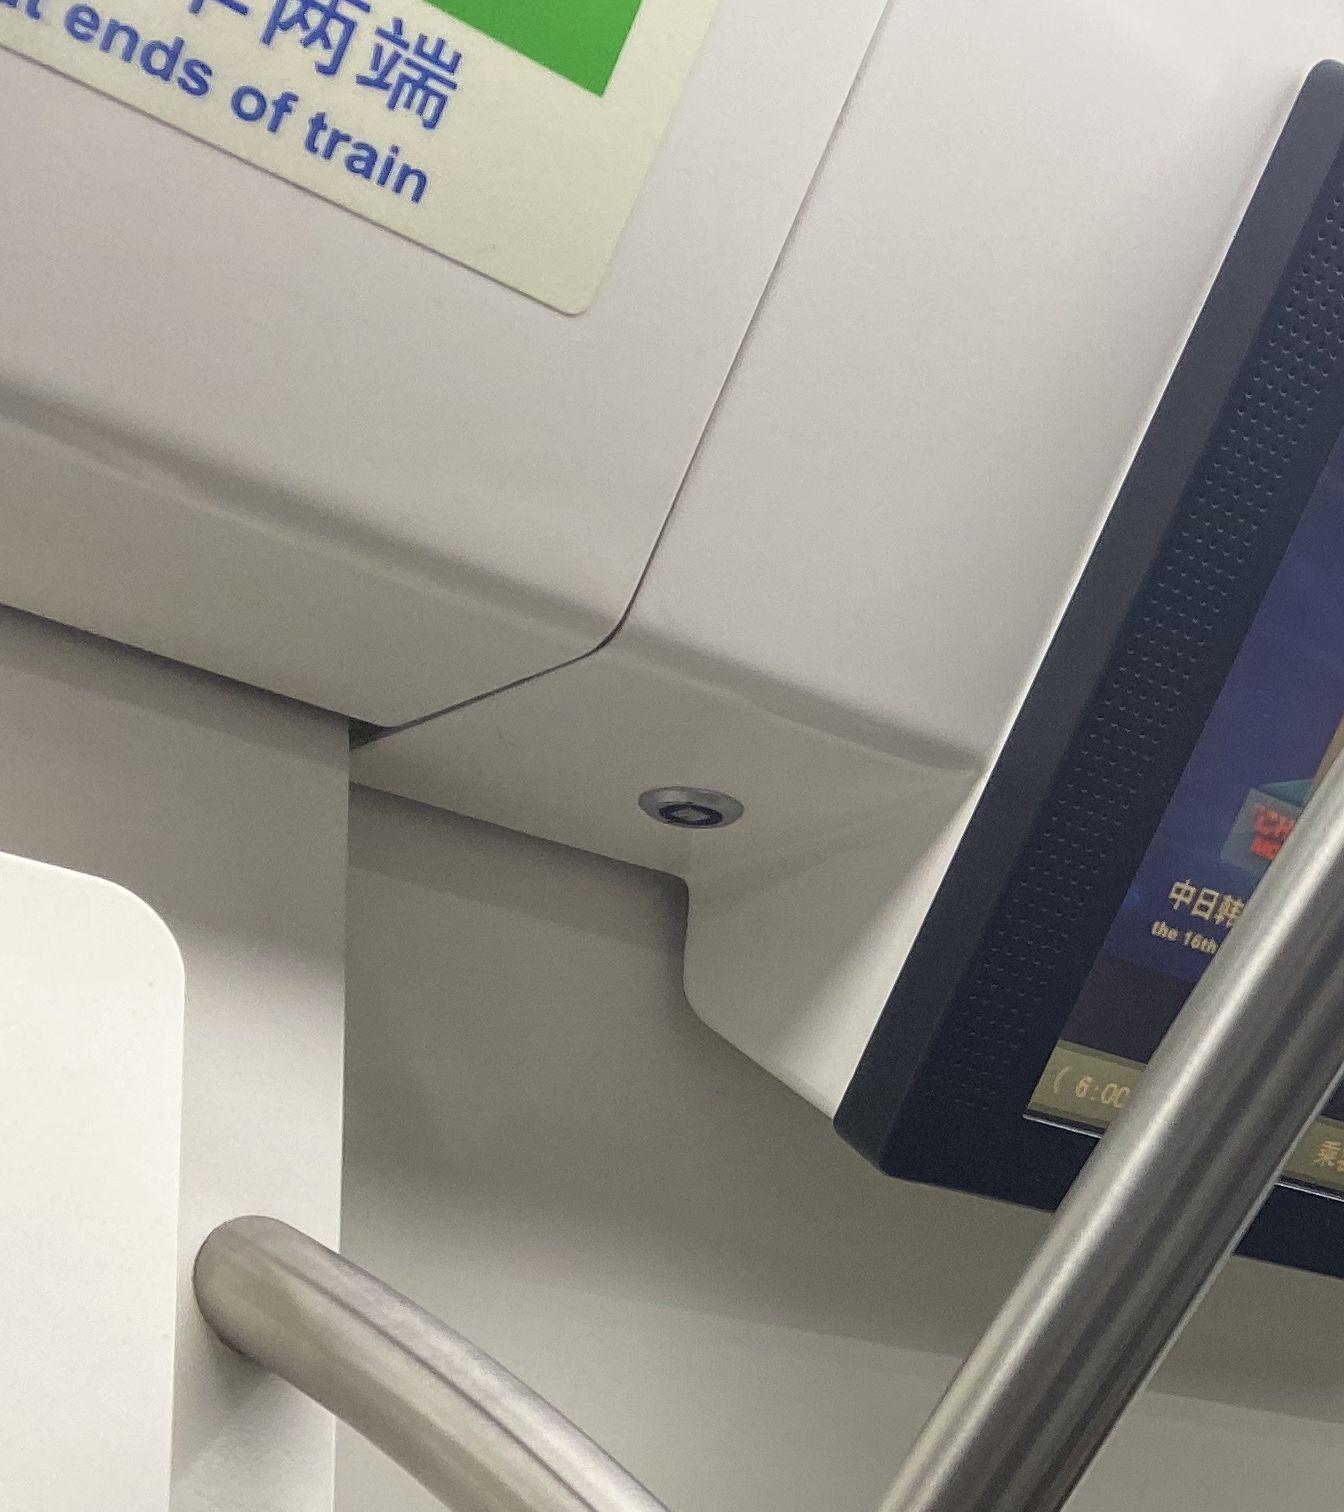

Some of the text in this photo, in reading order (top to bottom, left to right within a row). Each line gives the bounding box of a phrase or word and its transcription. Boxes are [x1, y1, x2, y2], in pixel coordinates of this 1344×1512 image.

[64, 2, 429, 204] ends of train
[187, 0, 463, 130] 两端
